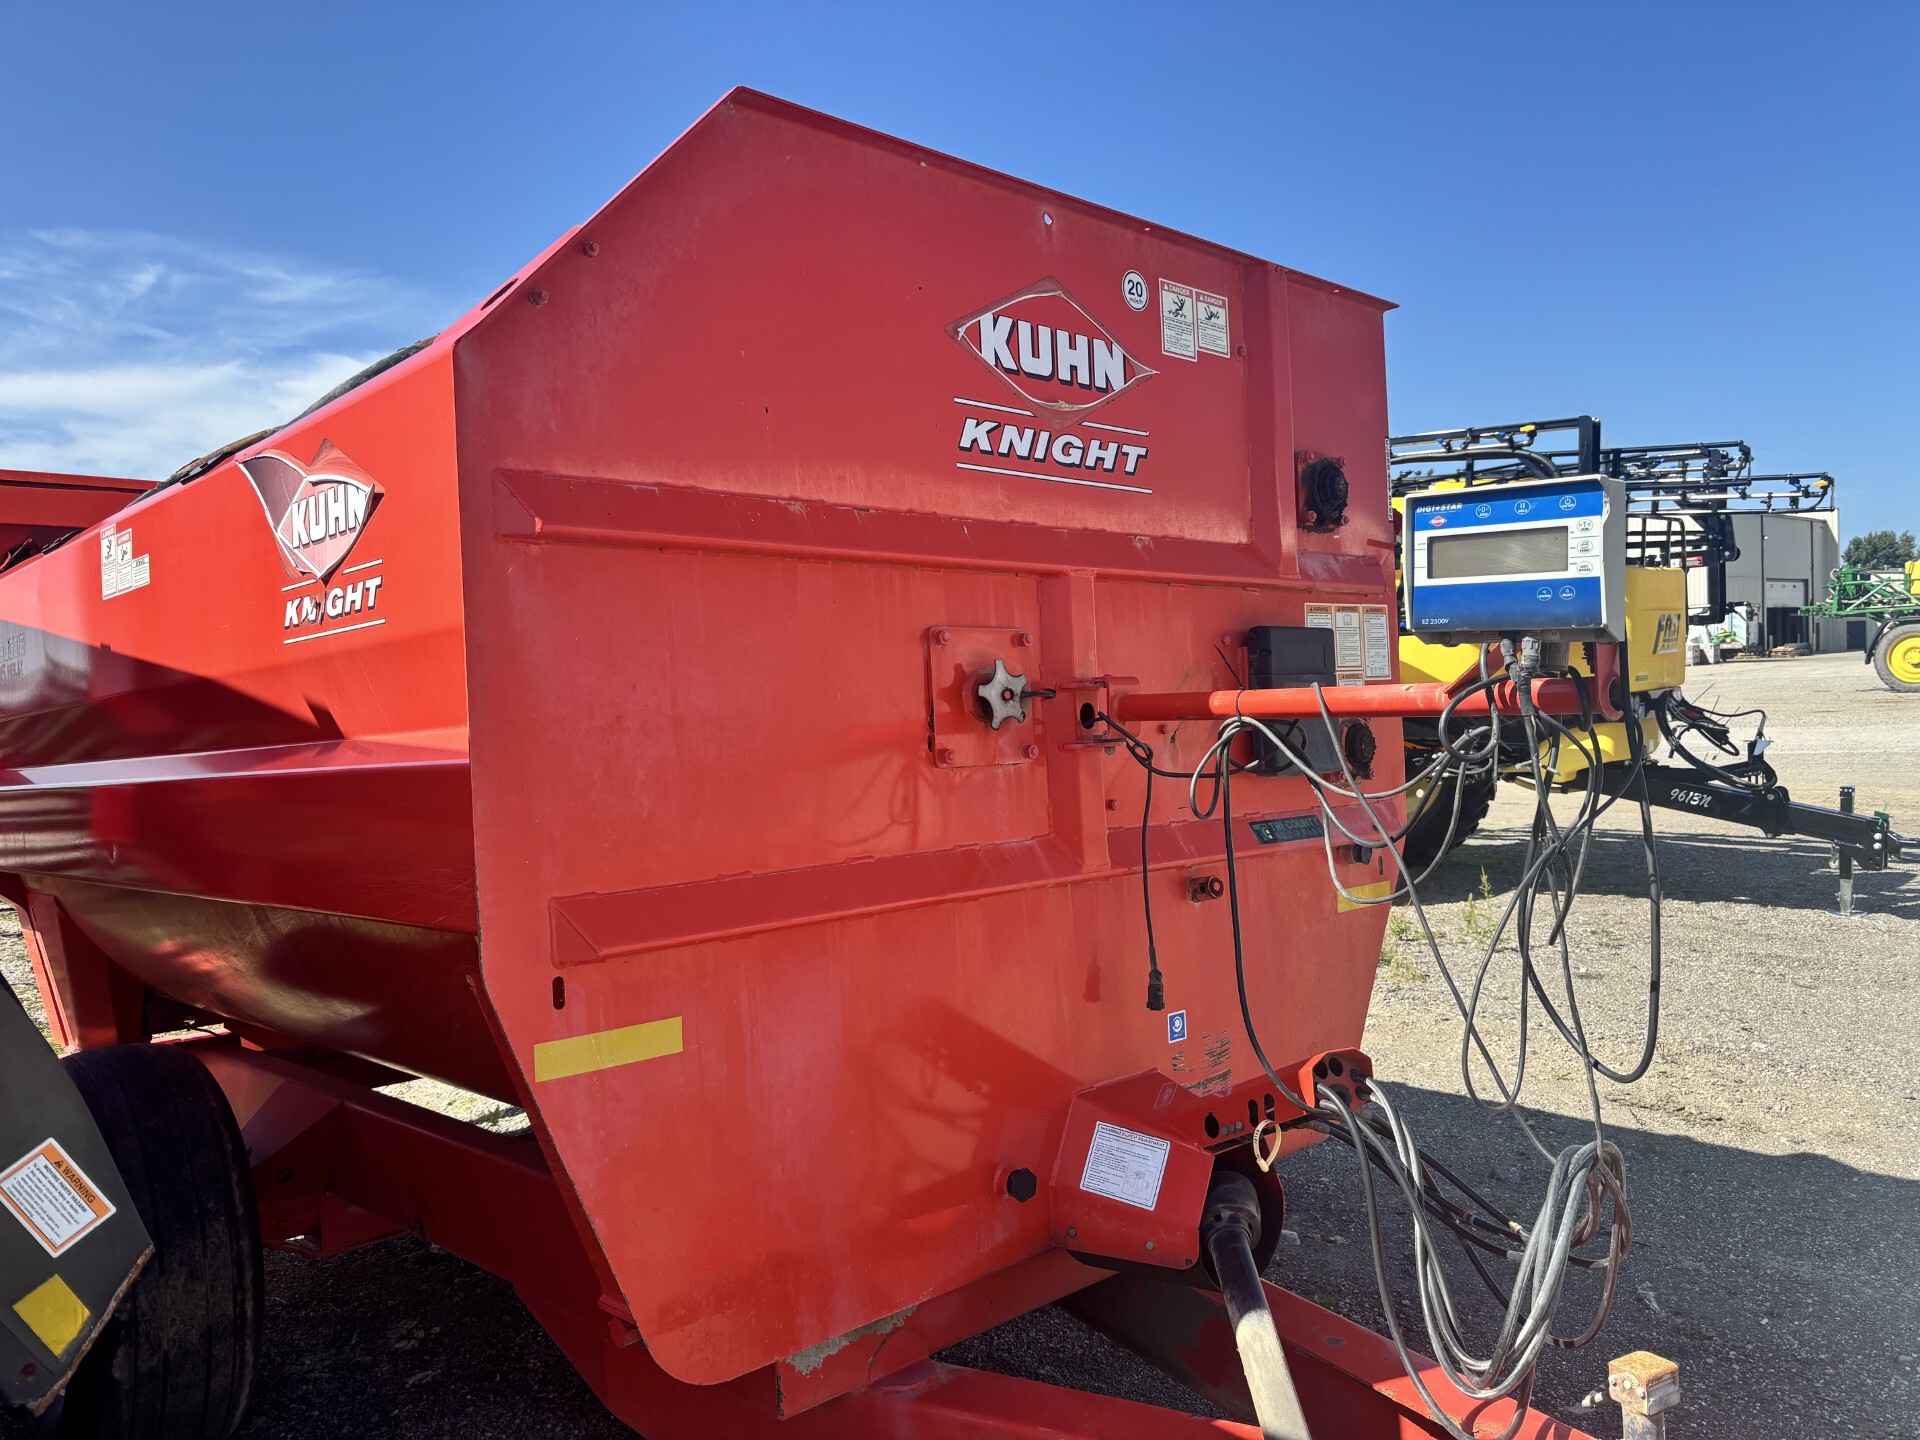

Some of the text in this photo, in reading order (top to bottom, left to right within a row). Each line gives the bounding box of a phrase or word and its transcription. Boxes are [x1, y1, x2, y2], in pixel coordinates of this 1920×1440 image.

[1128, 279, 1143, 298] 20
[1169, 284, 1190, 296] DANGER
[1204, 295, 1222, 306] DANGER
[978, 313, 1127, 393] KUHN
[958, 417, 1148, 476] KNIGHT
[291, 484, 370, 550] KUHN
[1286, 817, 1319, 829] COUNTY
[43, 1165, 87, 1213] MOVING PARTS HAZARD
[63, 1166, 95, 1203] WARNING
